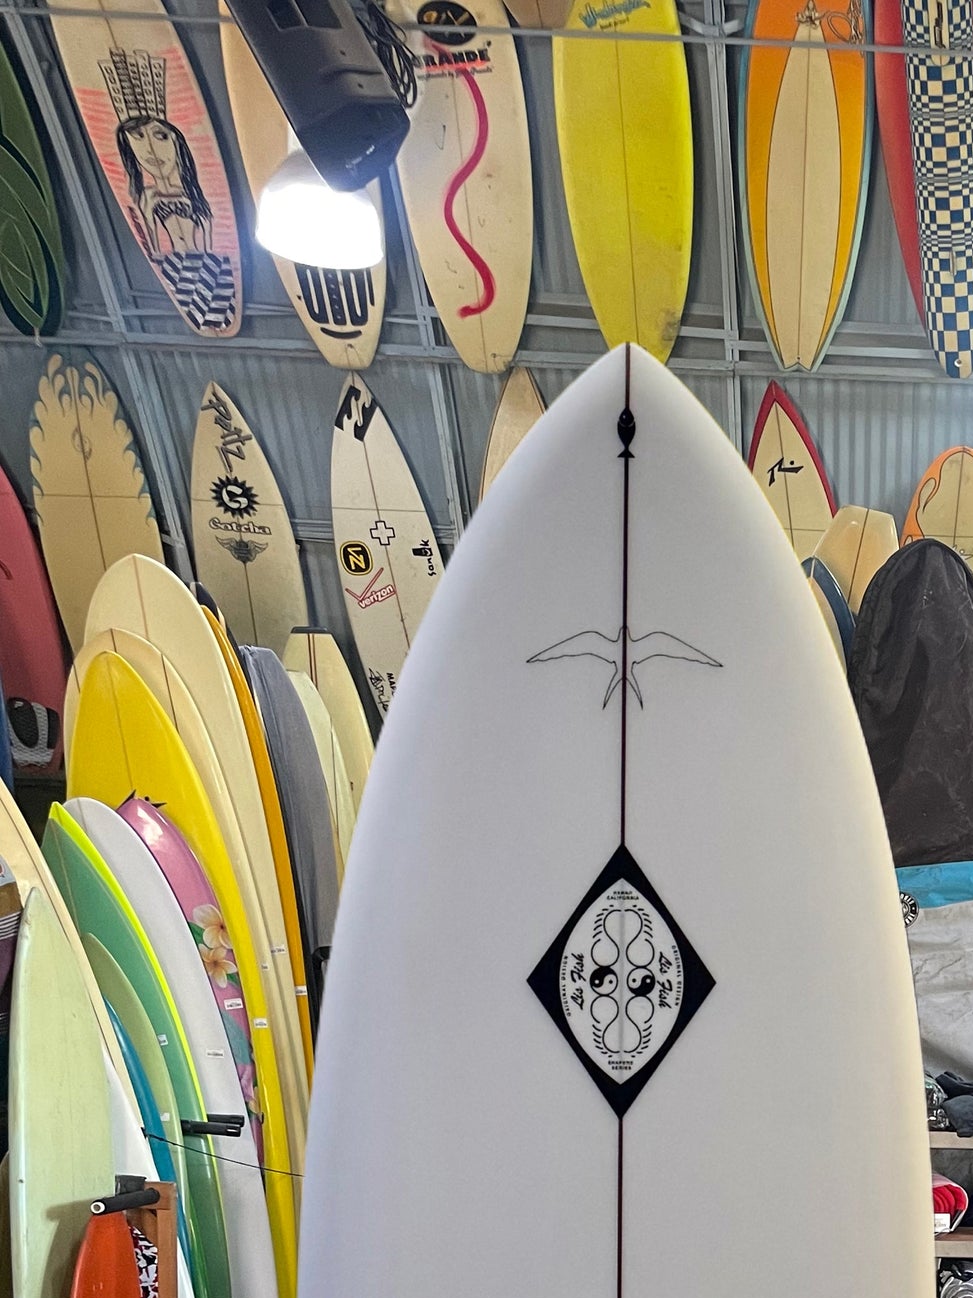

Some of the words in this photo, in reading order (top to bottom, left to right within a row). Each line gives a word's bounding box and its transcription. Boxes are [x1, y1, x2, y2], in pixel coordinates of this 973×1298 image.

[209, 517, 272, 536] Gotcha
[358, 584, 396, 609] verizon
[571, 952, 586, 983] Fish
[657, 979, 673, 1009] Fish
